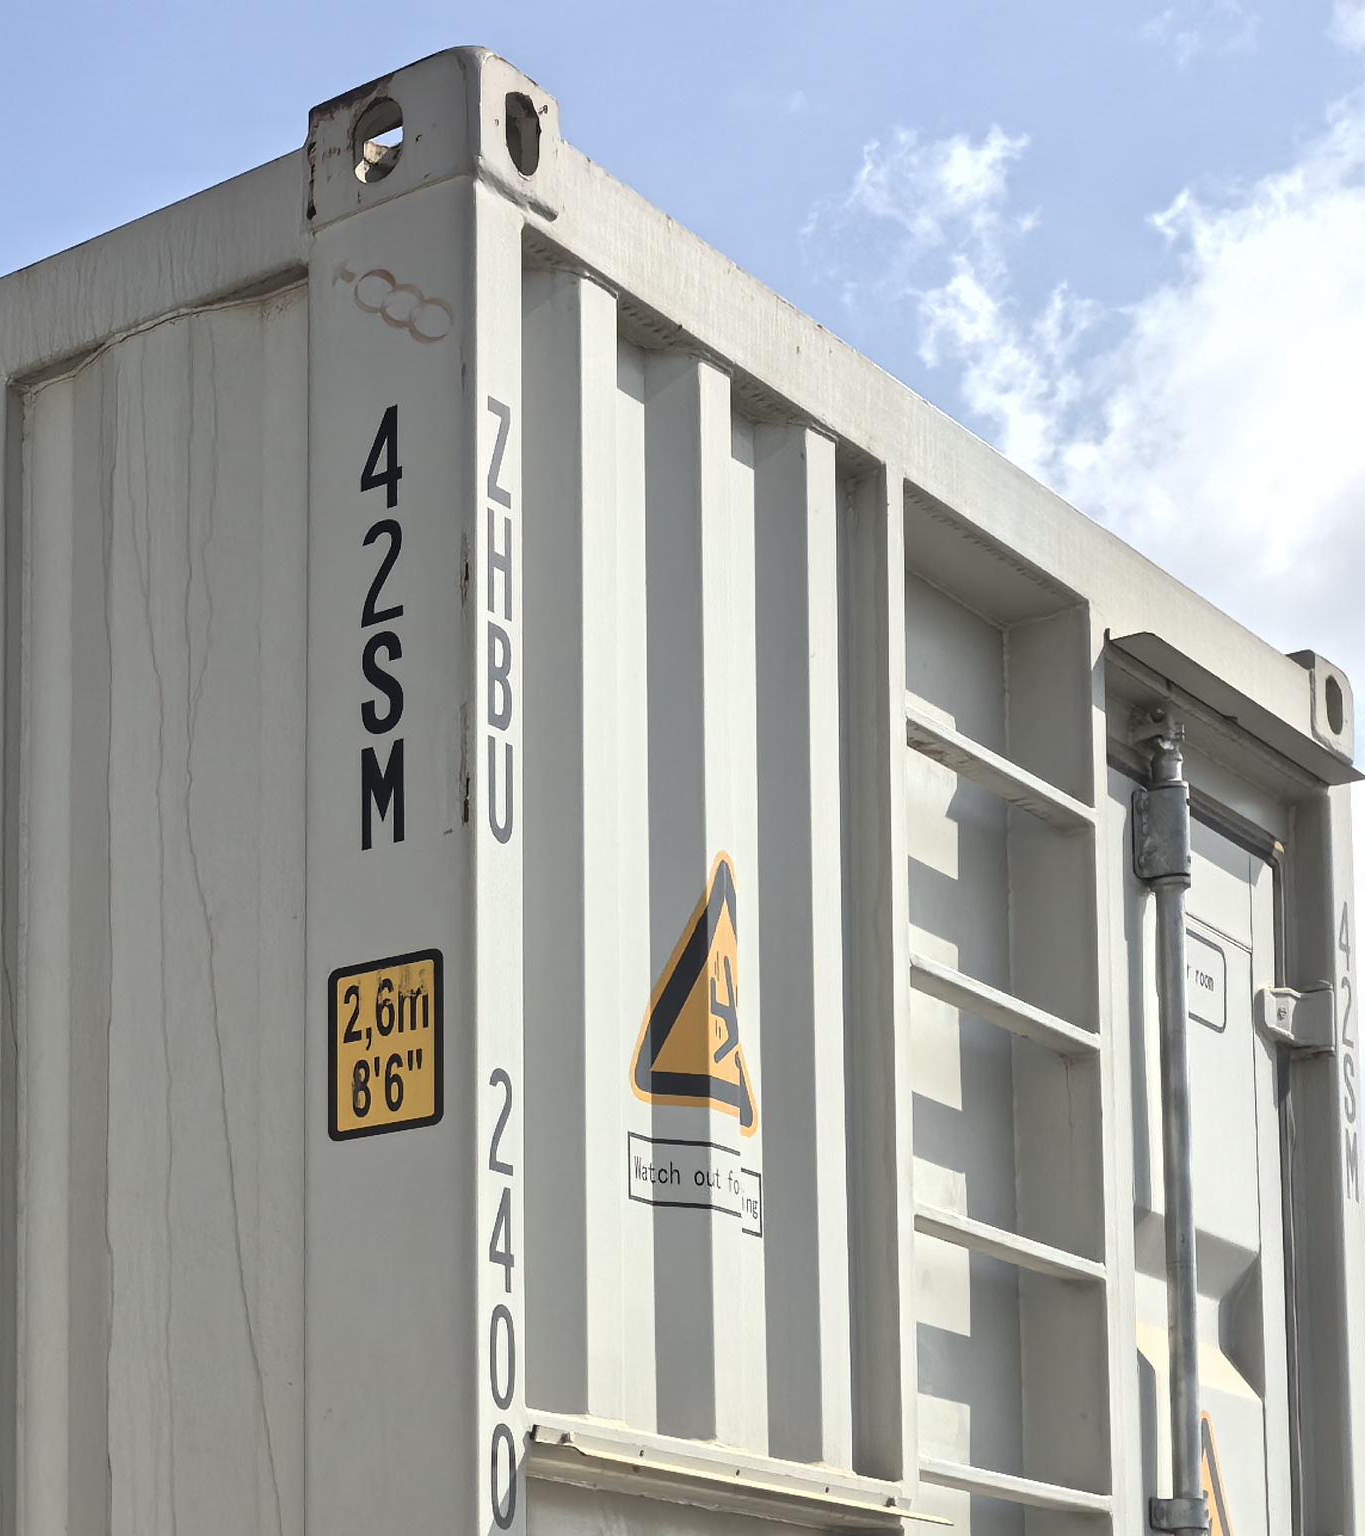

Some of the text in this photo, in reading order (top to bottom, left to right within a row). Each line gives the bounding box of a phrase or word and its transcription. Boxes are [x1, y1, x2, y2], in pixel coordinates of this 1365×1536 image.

[359, 404, 405, 851] 42SM
[486, 395, 514, 844] ZHBU
[342, 978, 429, 1050] 2,6m
[1338, 900, 1360, 1205] 42SM
[633, 1155, 681, 1186] Watch
[694, 1168, 721, 1190] out
[726, 1169, 742, 1195] fo
